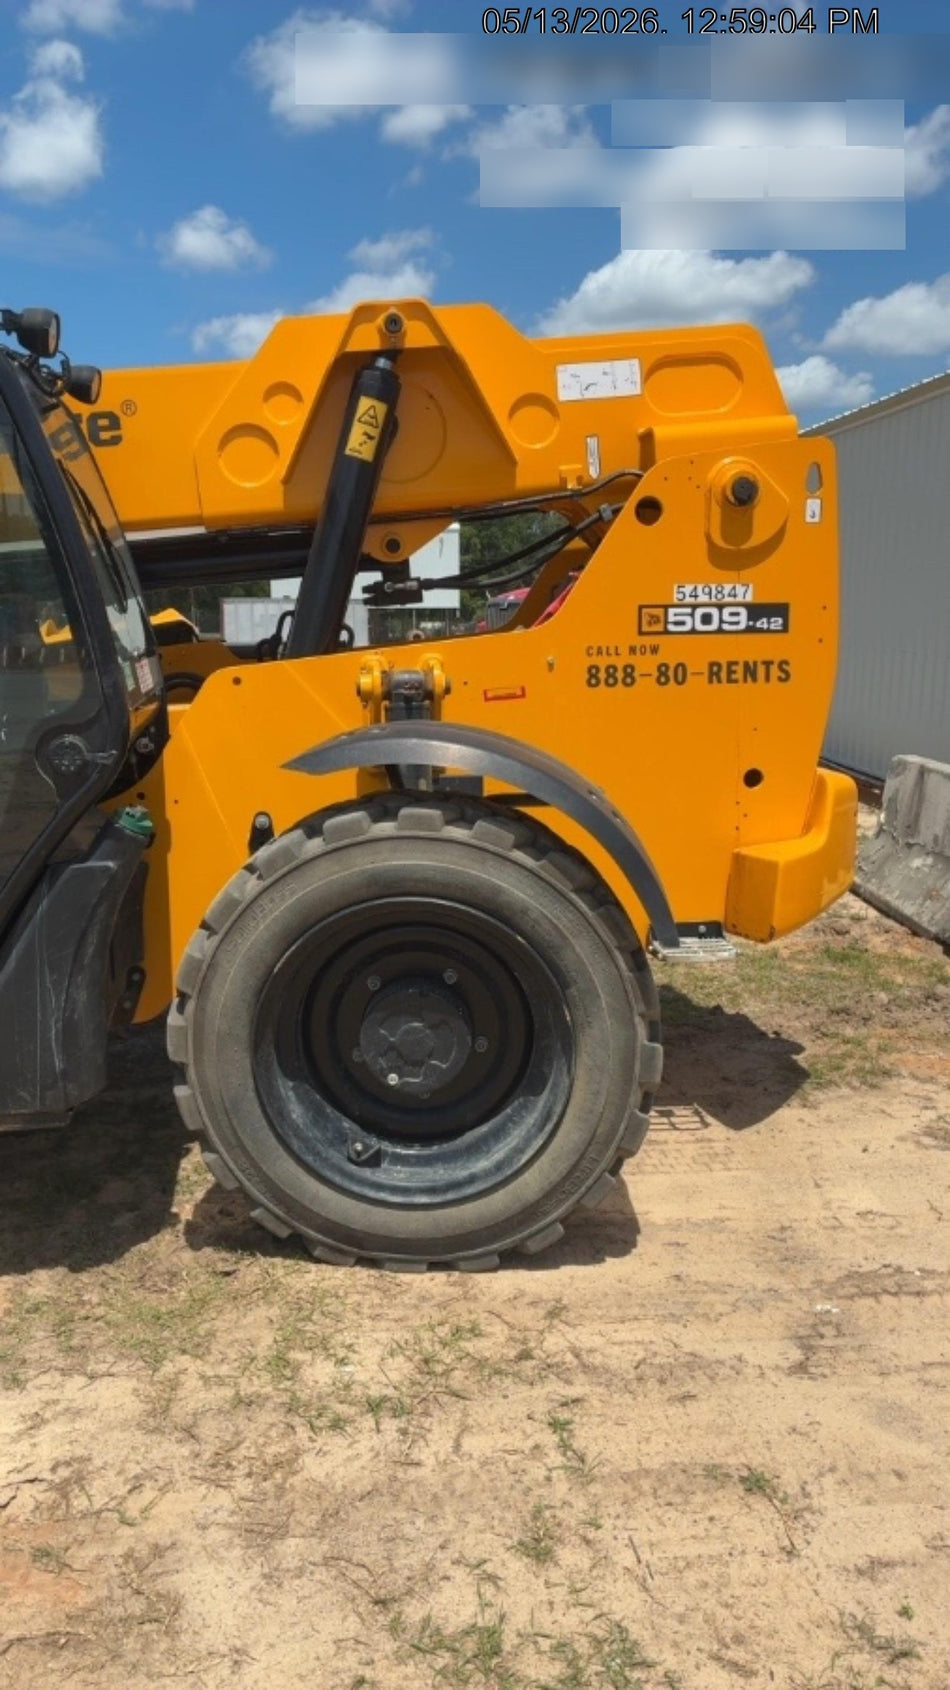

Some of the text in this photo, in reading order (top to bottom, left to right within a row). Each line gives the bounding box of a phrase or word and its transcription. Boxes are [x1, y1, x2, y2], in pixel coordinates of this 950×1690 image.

[675, 584, 750, 601] 549847
[586, 643, 660, 657] CALL NOW
[586, 660, 791, 688] 888-80-RENTS
